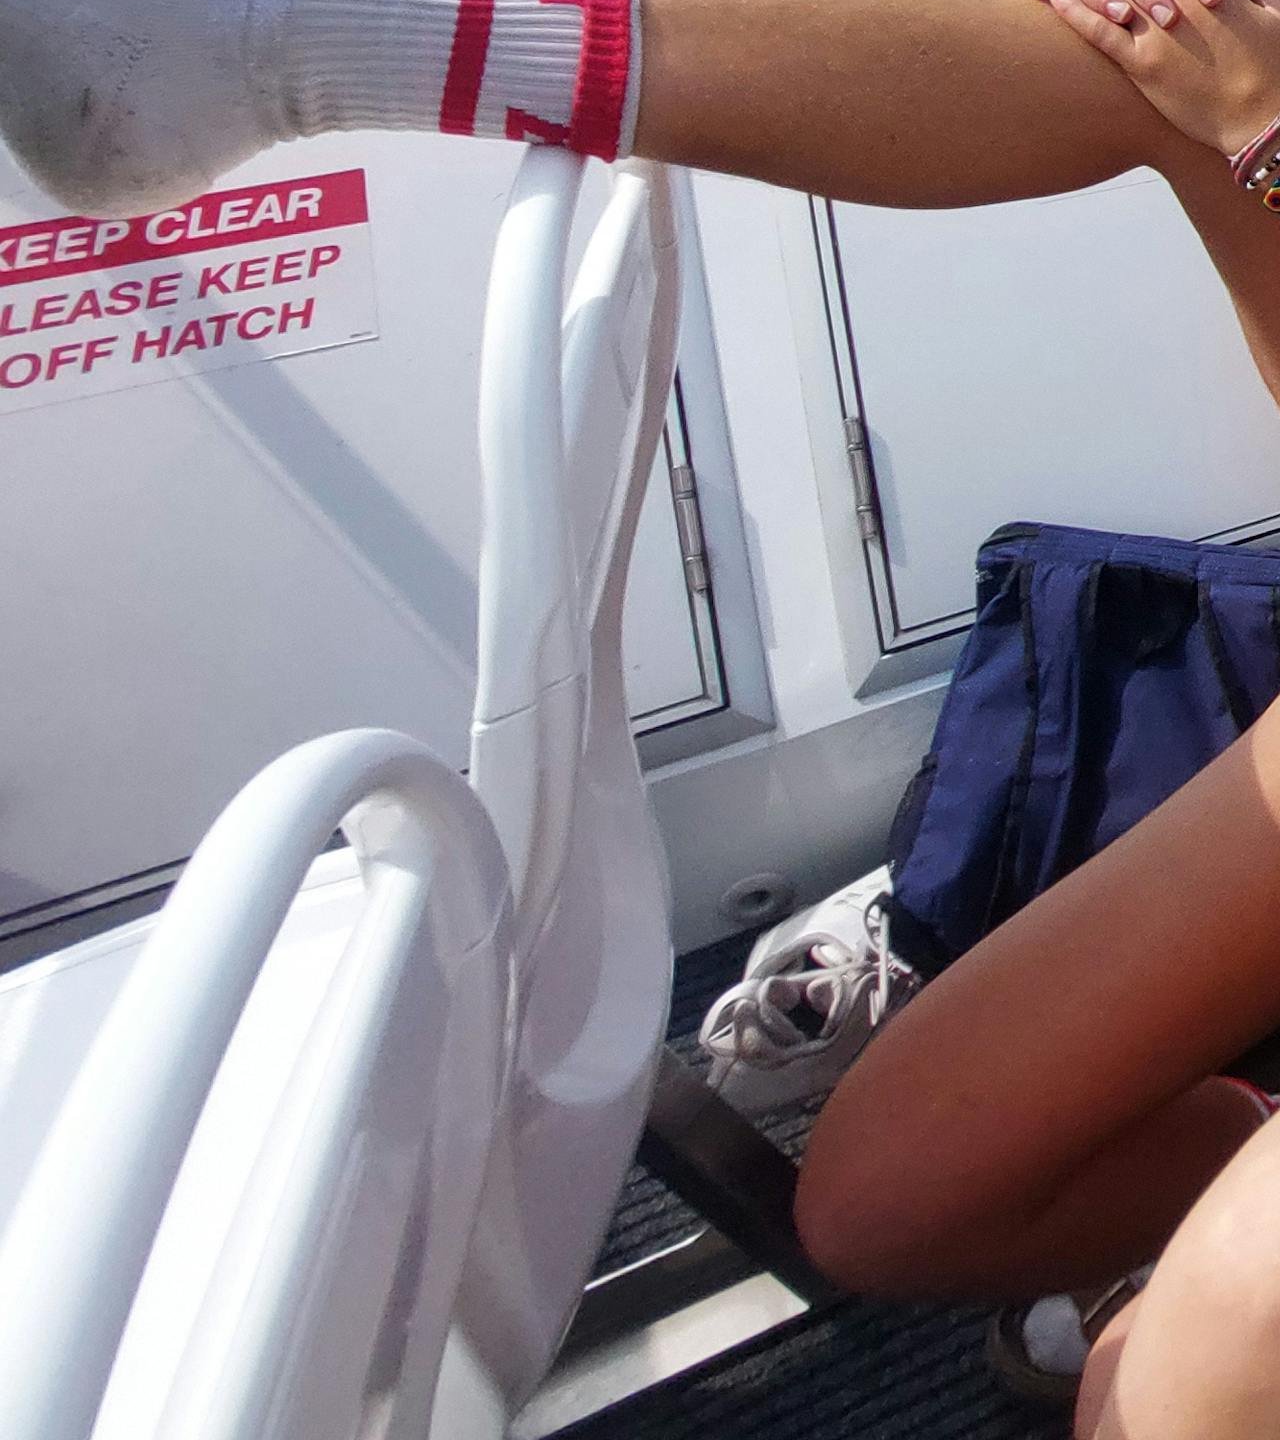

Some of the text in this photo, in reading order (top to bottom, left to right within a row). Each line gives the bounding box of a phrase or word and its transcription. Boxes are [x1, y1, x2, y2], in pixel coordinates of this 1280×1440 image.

[145, 186, 323, 245] CLEAR
[197, 245, 341, 300] KEEP
[0, 297, 315, 389] OFF HATCH
